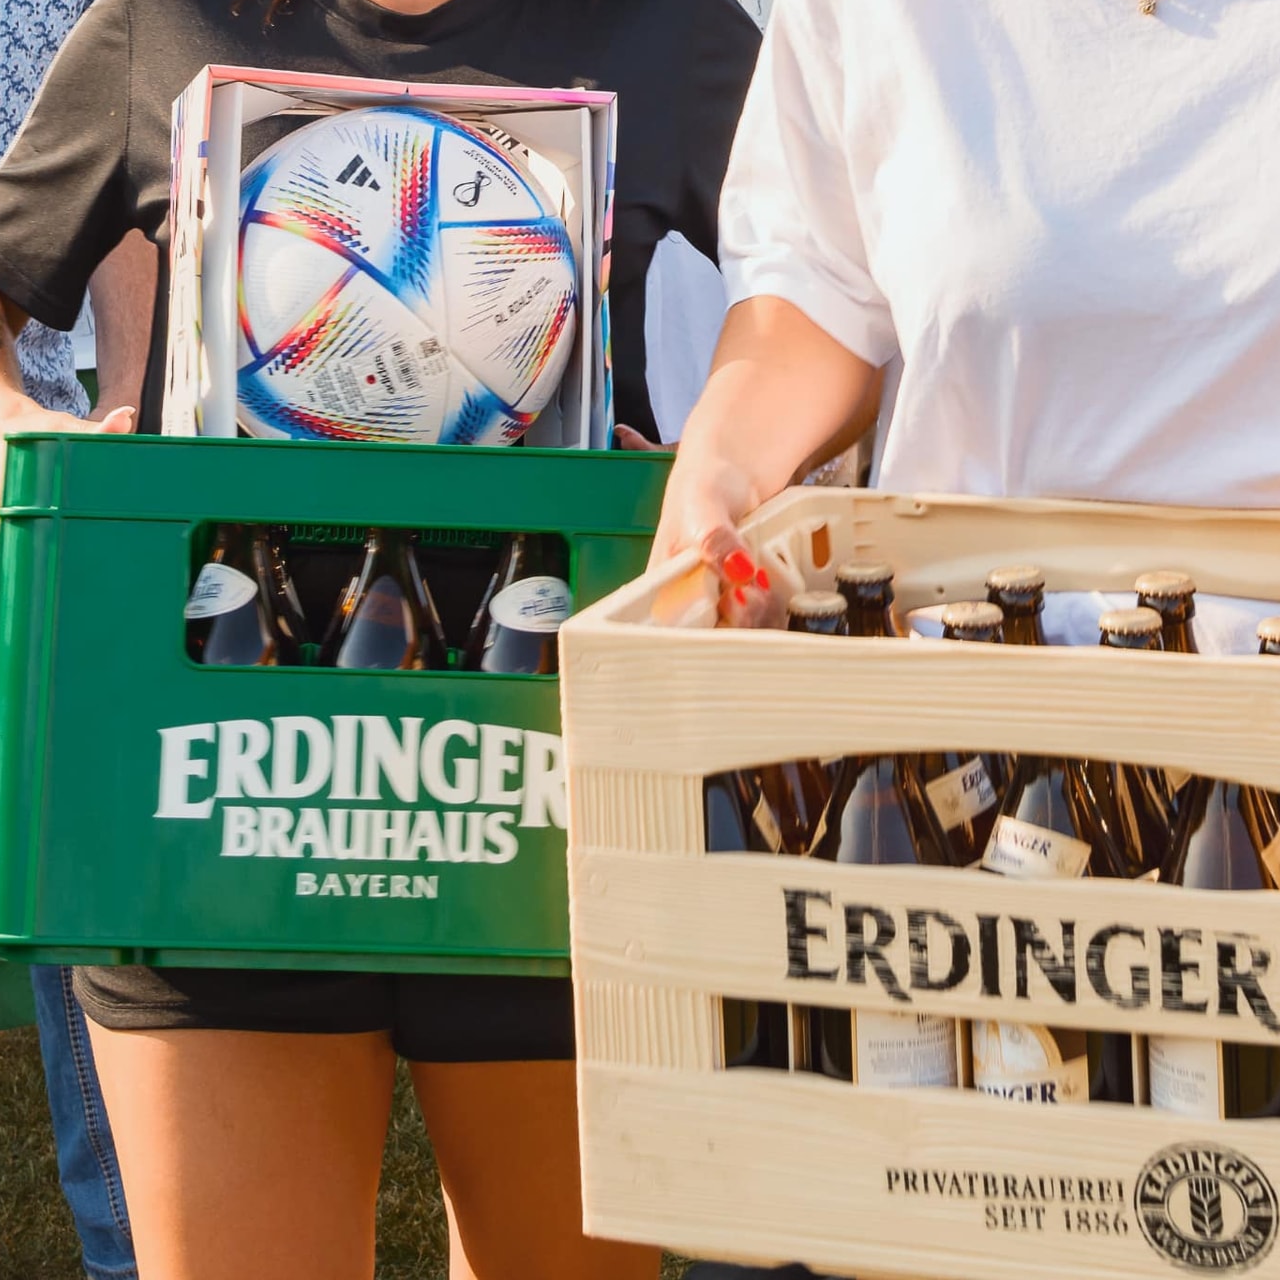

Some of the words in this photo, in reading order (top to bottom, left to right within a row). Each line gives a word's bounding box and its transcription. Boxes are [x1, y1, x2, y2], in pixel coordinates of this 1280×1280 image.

[375, 355, 395, 395] adidas
[153, 714, 568, 830] ERDINGER
[220, 806, 519, 865] BRAUHAUS
[295, 872, 439, 899] BAYERN
[885, 1166, 1126, 1204] PRIVATBRAUEREI
[1144, 1151, 1265, 1206] ERDINGER
[985, 1204, 1046, 1231] SEIT
[1063, 1209, 1130, 1237] 1886
